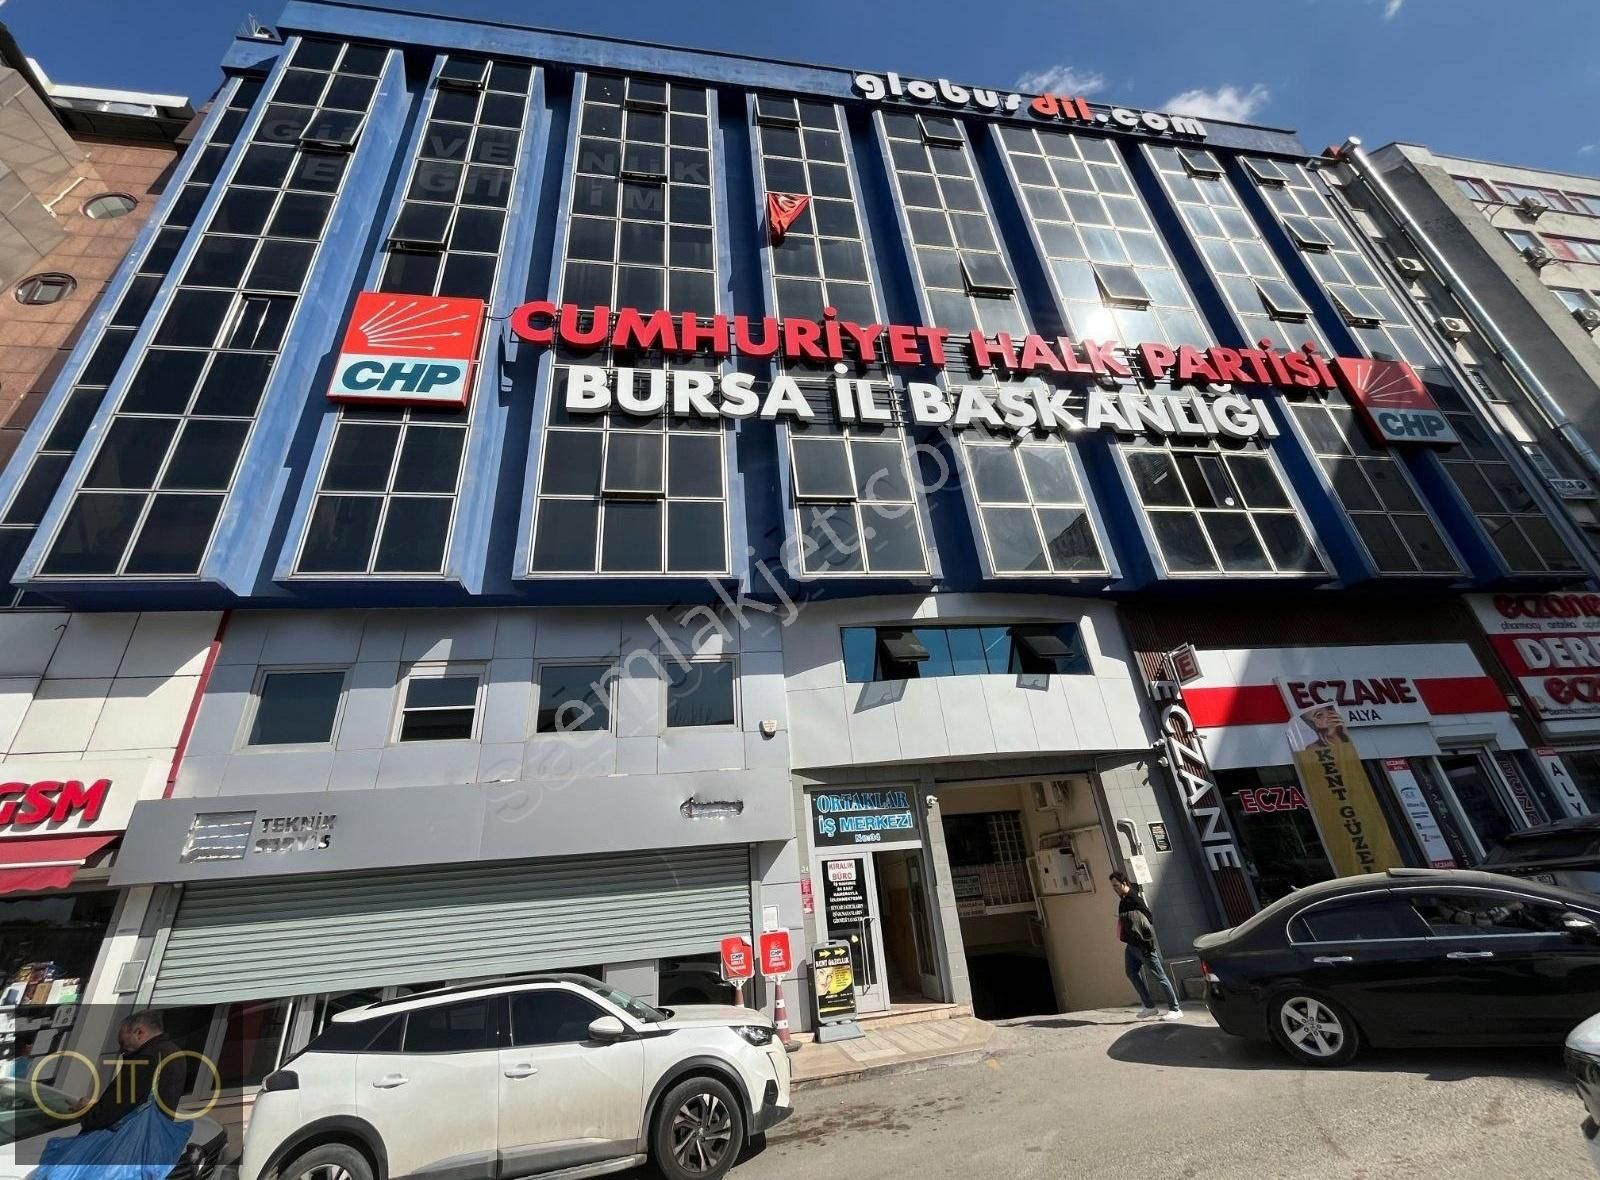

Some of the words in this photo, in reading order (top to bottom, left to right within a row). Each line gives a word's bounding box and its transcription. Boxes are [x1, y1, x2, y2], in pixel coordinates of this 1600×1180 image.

[511, 300, 948, 369] CUMHURİYET
[969, 330, 1132, 378] HALK
[1137, 336, 1337, 390] PARTİSİ
[341, 360, 461, 394] CHP
[566, 364, 815, 421] BURSA
[834, 363, 892, 424] İL
[908, 381, 1281, 446] BAŞKANLIĞI
[1378, 411, 1446, 438] CHP
[1287, 678, 1418, 709] ECZANE
[1349, 709, 1382, 722] ALYA
[1149, 681, 1242, 871] ECZANE
[1315, 749, 1347, 801] KENT
[0, 779, 113, 825] GSM
[816, 791, 910, 813] ORTAKLAR
[261, 811, 337, 834] TEKNİK
[818, 814, 836, 838] İŞ
[840, 810, 914, 833] MERKEZİ
